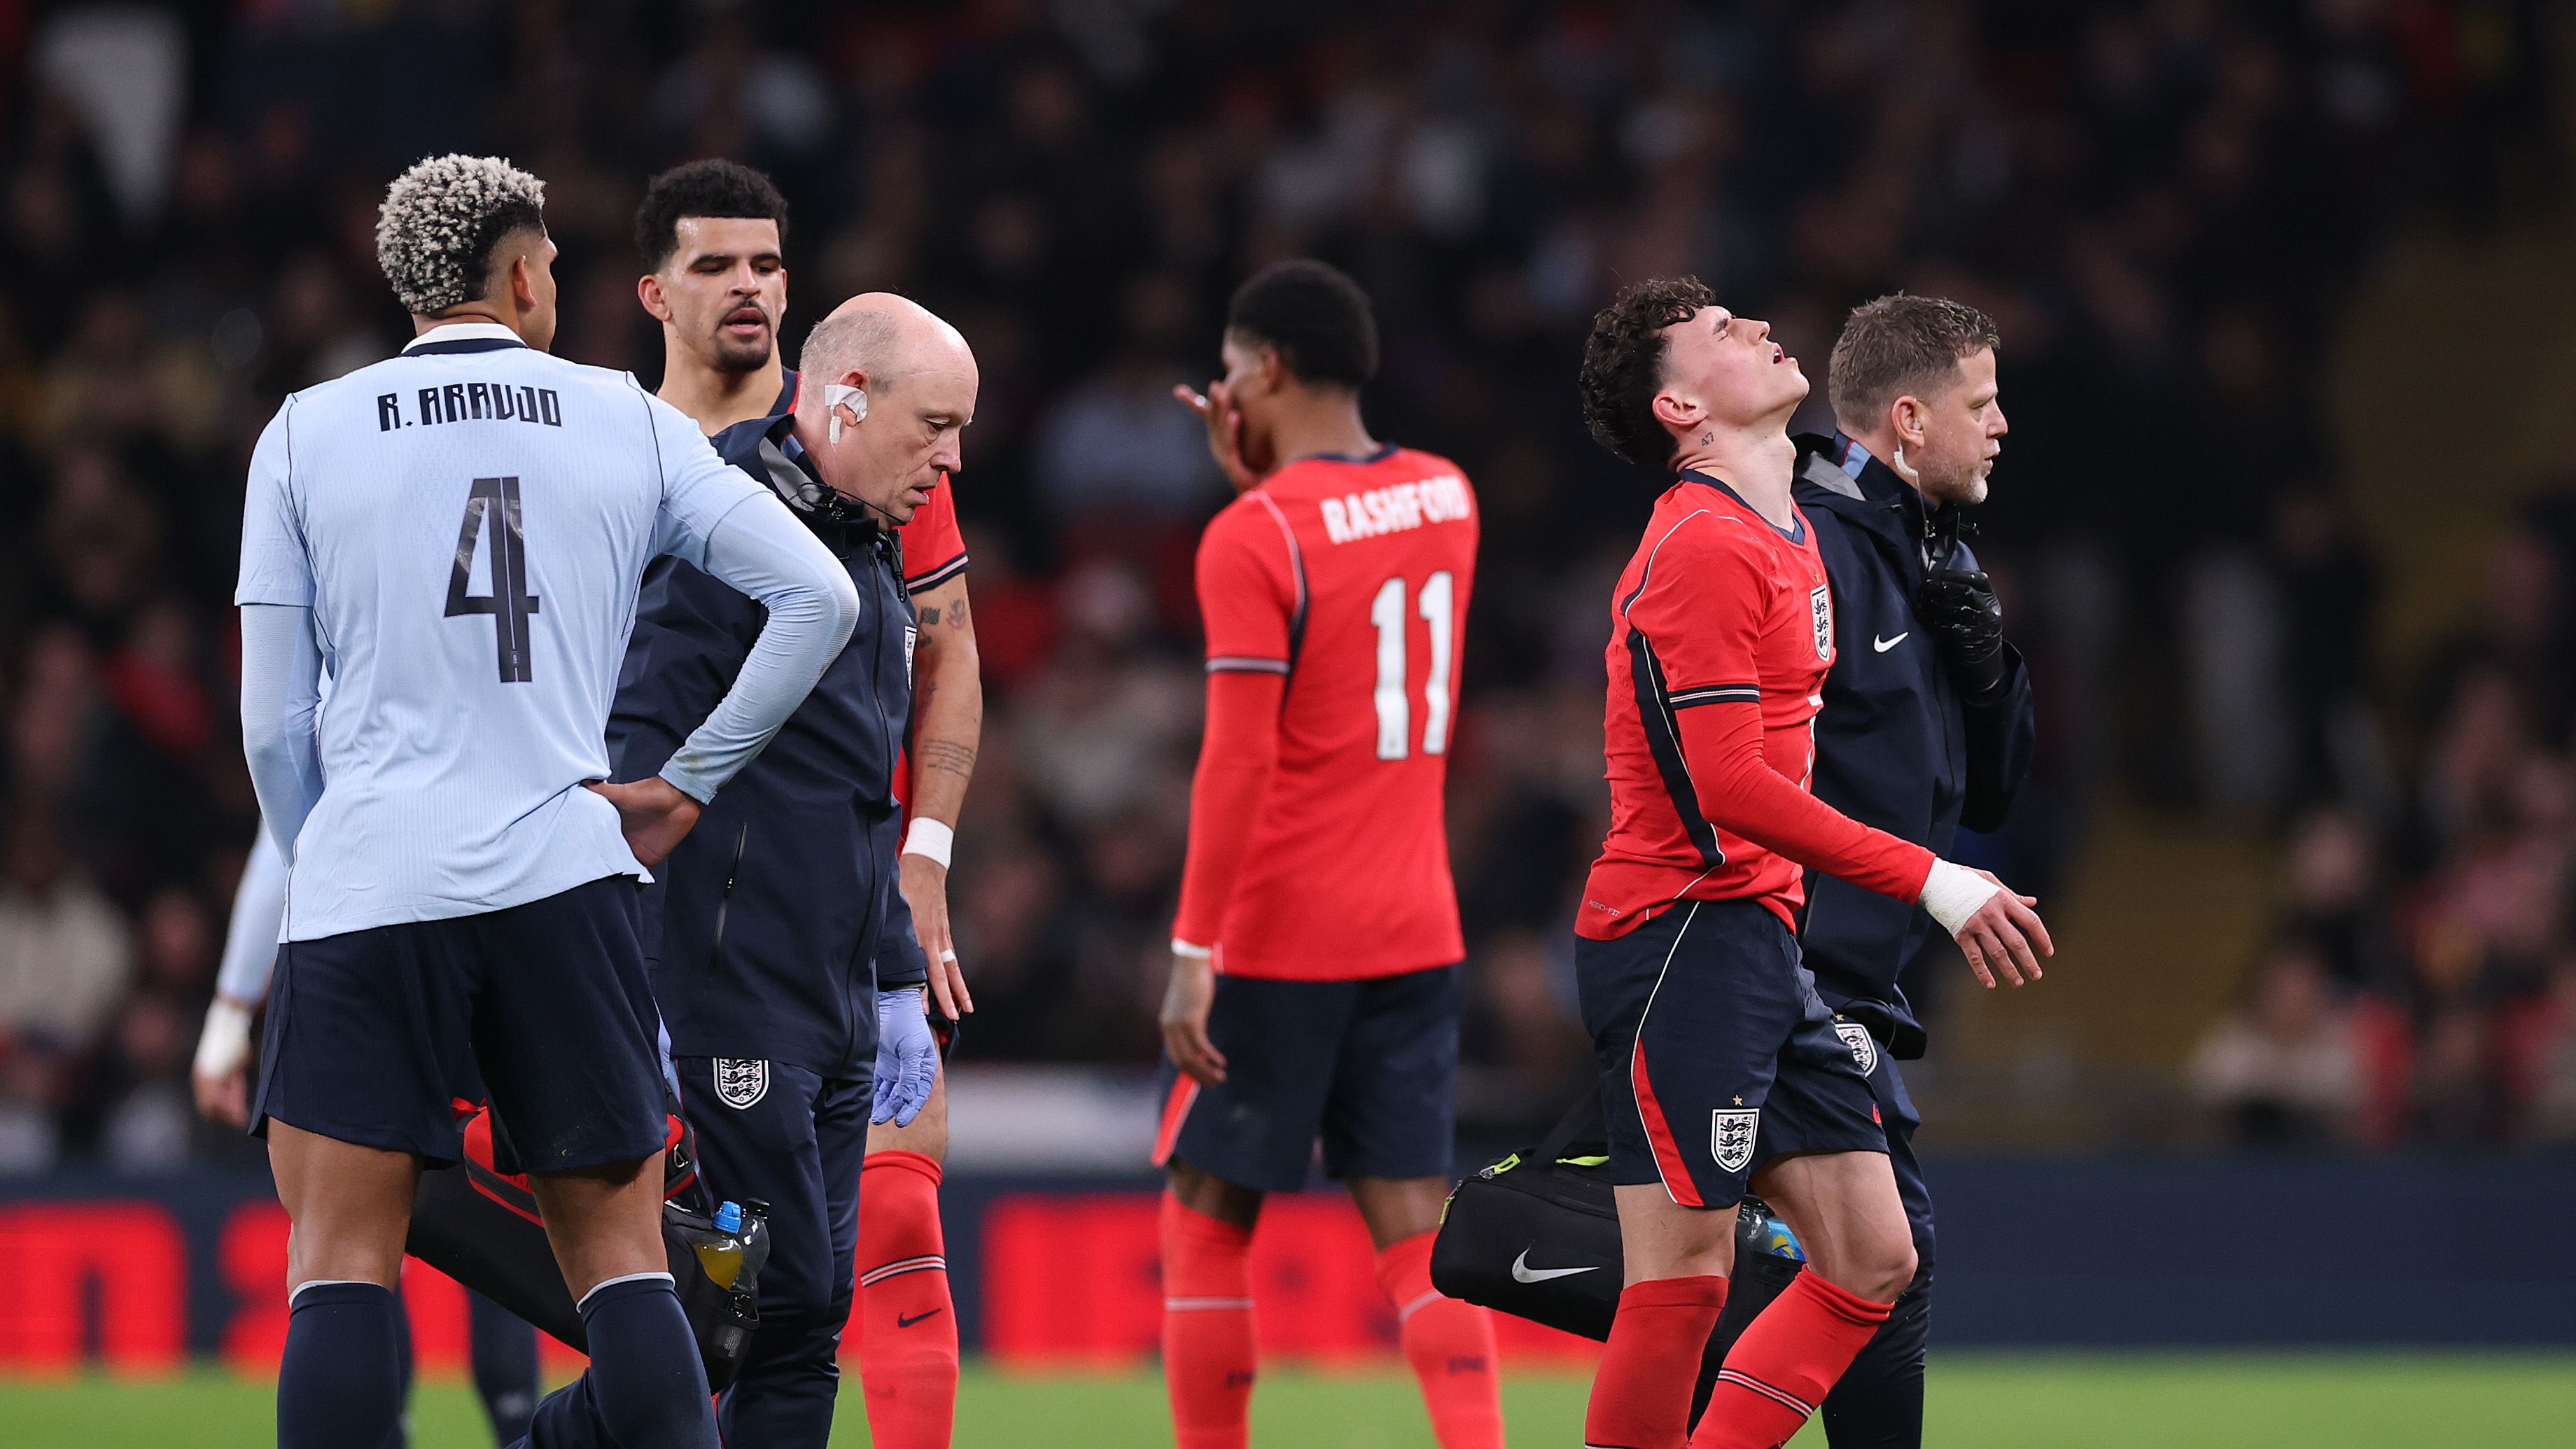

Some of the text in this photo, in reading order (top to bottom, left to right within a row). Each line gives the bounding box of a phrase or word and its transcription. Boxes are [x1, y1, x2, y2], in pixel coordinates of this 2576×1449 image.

[377, 383, 562, 432] R. ARAUJO
[1320, 474, 1470, 545] RASHFORD
[444, 476, 540, 683] 4
[1371, 570, 1453, 761] 11
